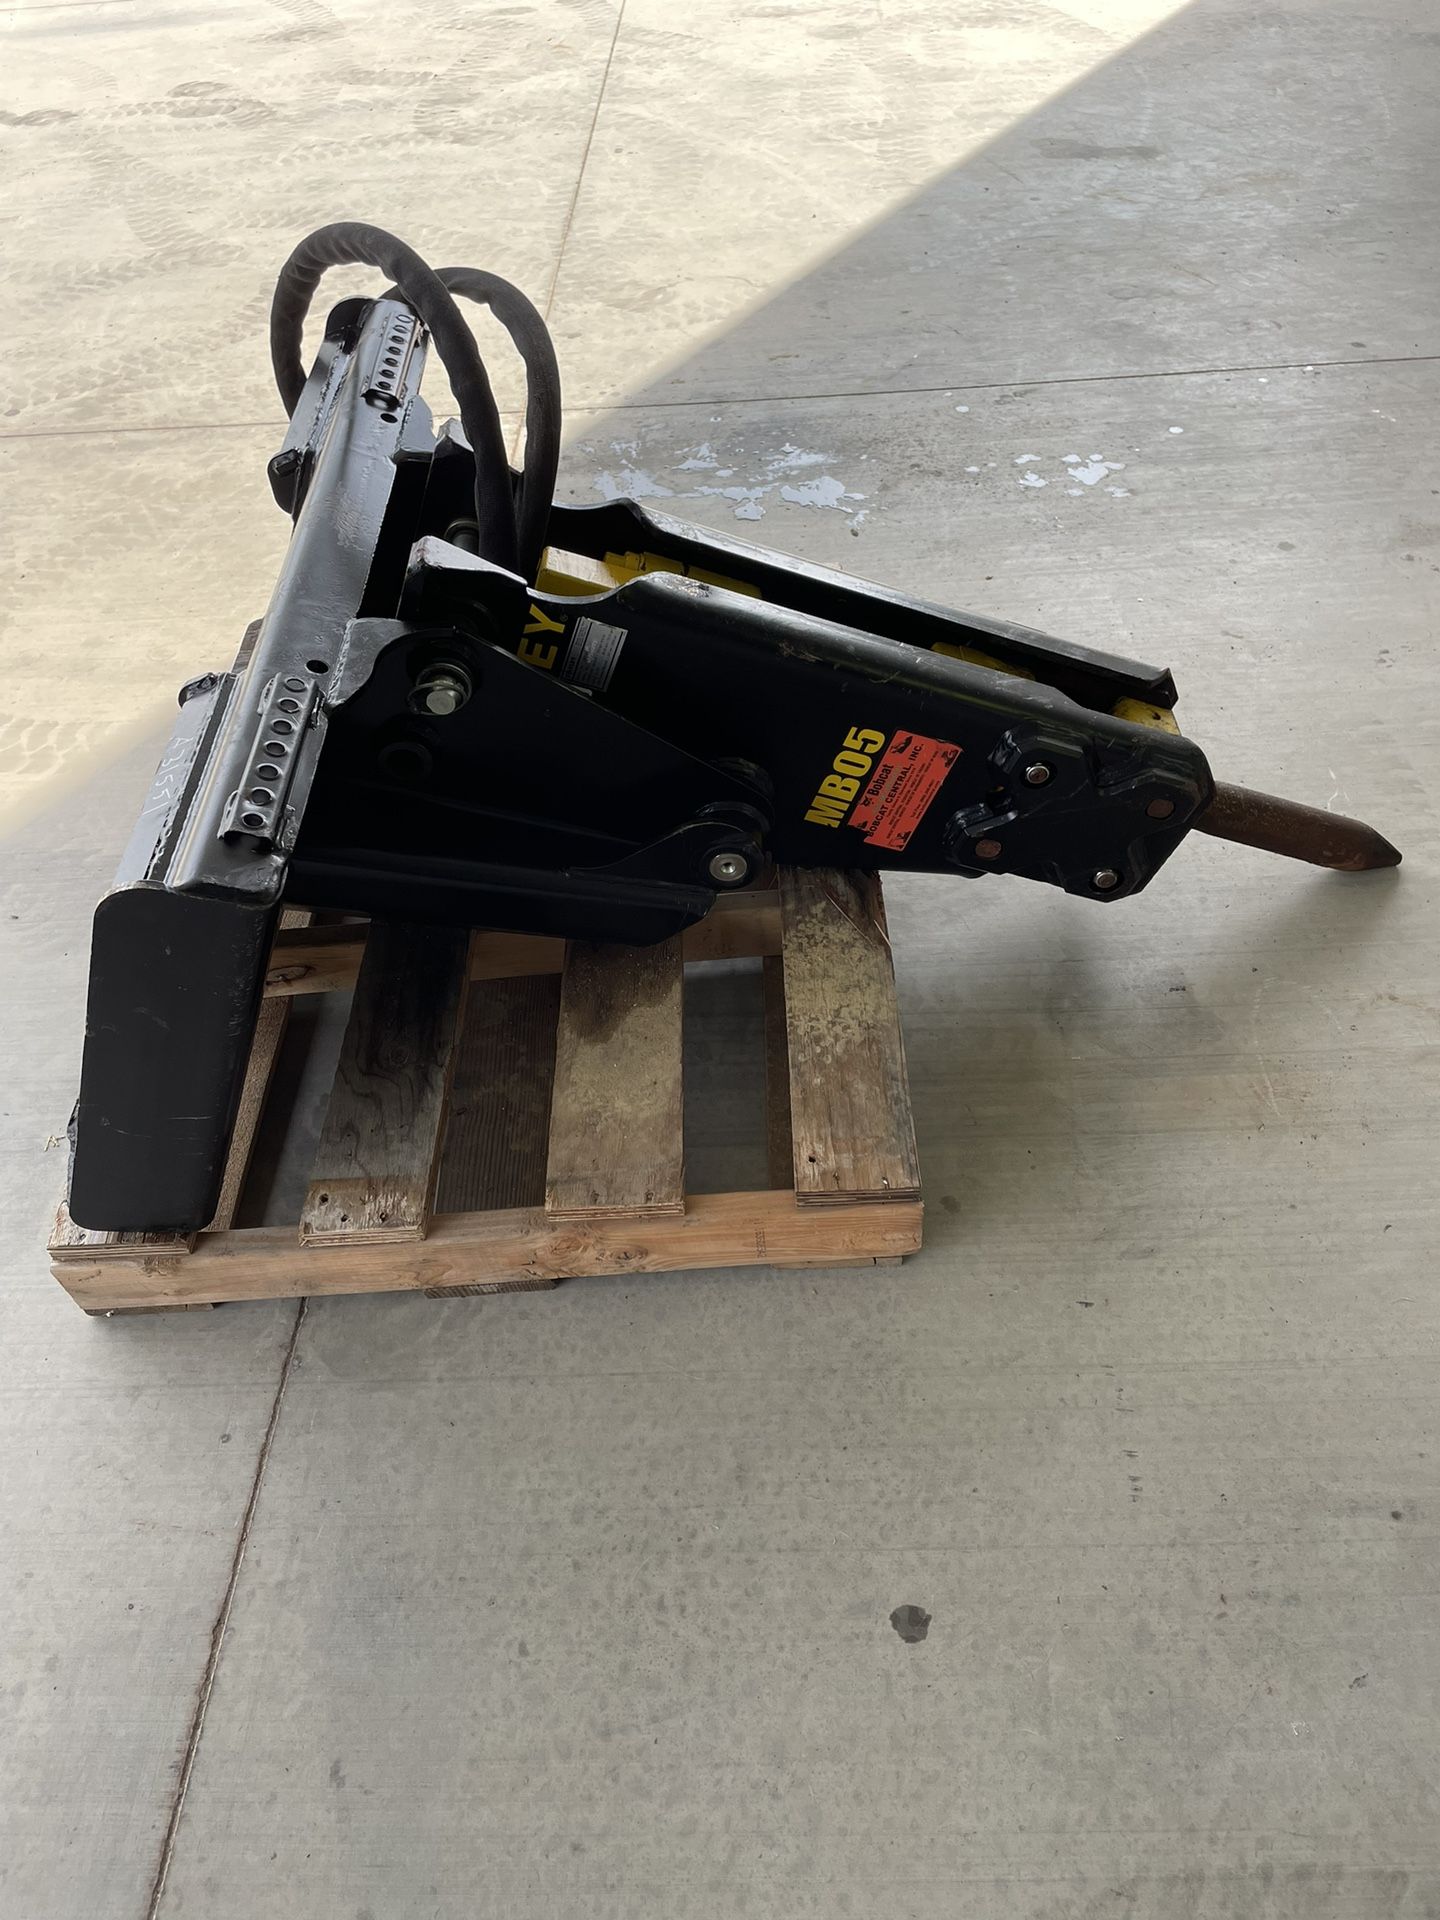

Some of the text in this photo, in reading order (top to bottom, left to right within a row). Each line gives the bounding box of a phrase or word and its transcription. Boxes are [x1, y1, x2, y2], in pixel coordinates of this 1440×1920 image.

[804, 726, 886, 828] MB05
[867, 802, 890, 837] BOBCAT
[909, 743, 924, 762] INC.
[868, 764, 894, 797] Bobcat
